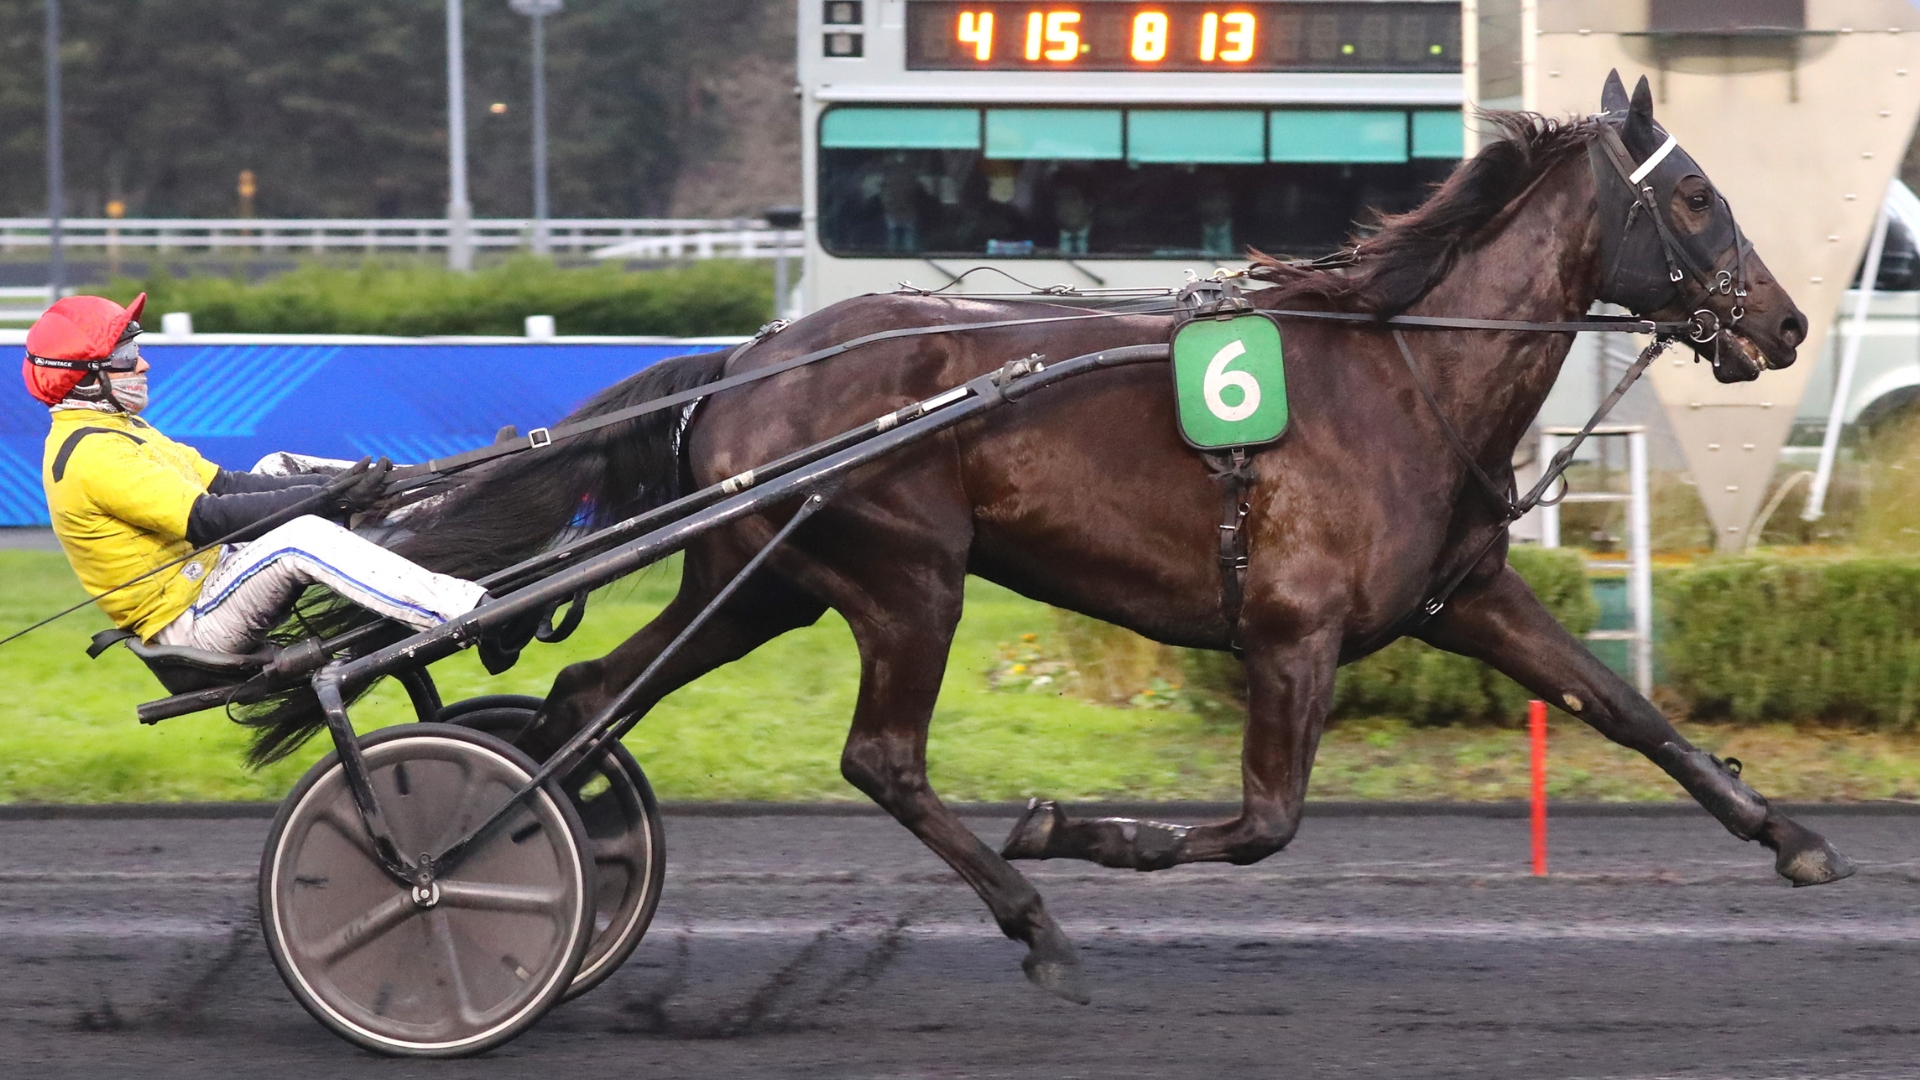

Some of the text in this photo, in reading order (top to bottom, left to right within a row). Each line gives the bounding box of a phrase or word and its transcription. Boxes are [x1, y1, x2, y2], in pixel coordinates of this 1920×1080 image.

[957, 11, 994, 61] 4
[1131, 12, 1168, 62] 8
[1200, 12, 1257, 62] 13
[1203, 339, 1261, 422] 6
